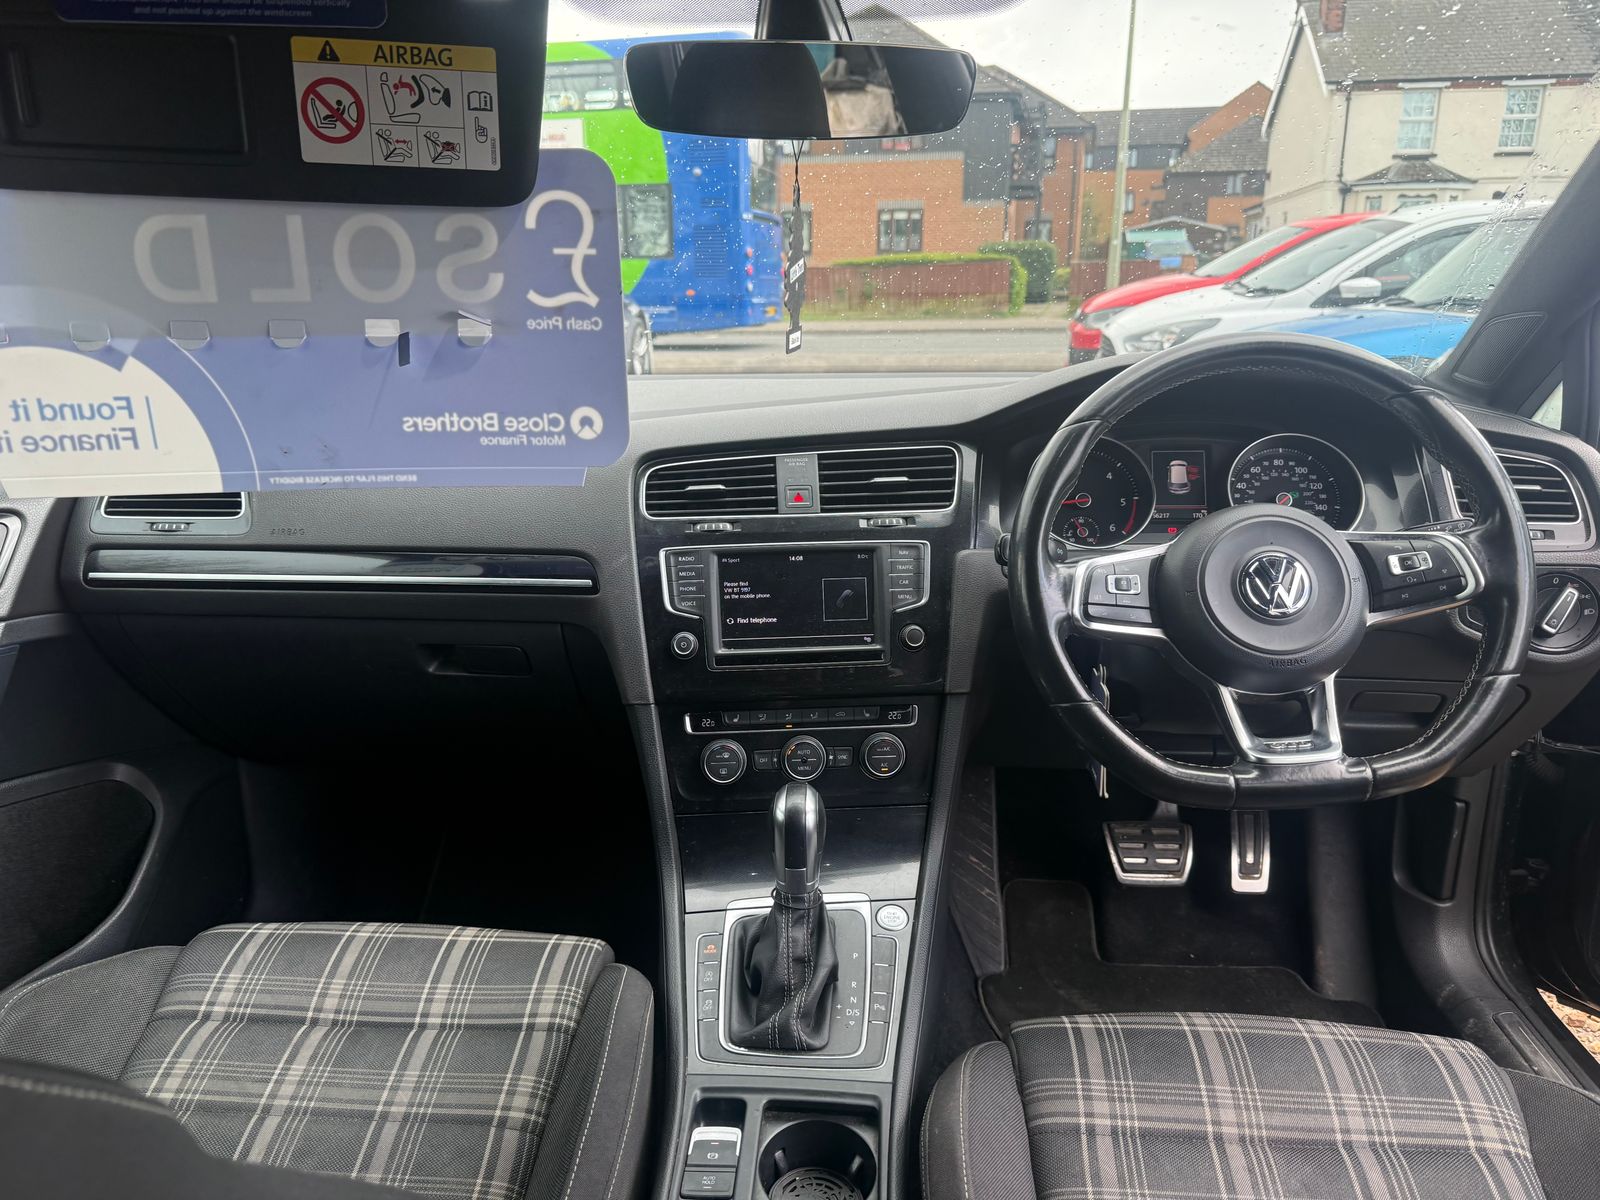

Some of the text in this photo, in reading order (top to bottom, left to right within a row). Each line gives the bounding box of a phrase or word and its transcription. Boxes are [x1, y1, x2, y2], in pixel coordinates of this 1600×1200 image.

[215, 8, 247, 17] against
[264, 8, 312, 17] windscreen
[374, 43, 454, 67] AIRBAG
[1294, 466, 1308, 474] 100
[1106, 472, 1112, 480] 4
[1236, 482, 1247, 490] 40
[1309, 482, 1323, 490] 120
[1120, 498, 1127, 507] 5
[1109, 523, 1116, 532] 6
[750, 616, 778, 624] telephone
[851, 981, 857, 989] R
[850, 996, 857, 1004] N
[846, 1009, 860, 1017] D/S
